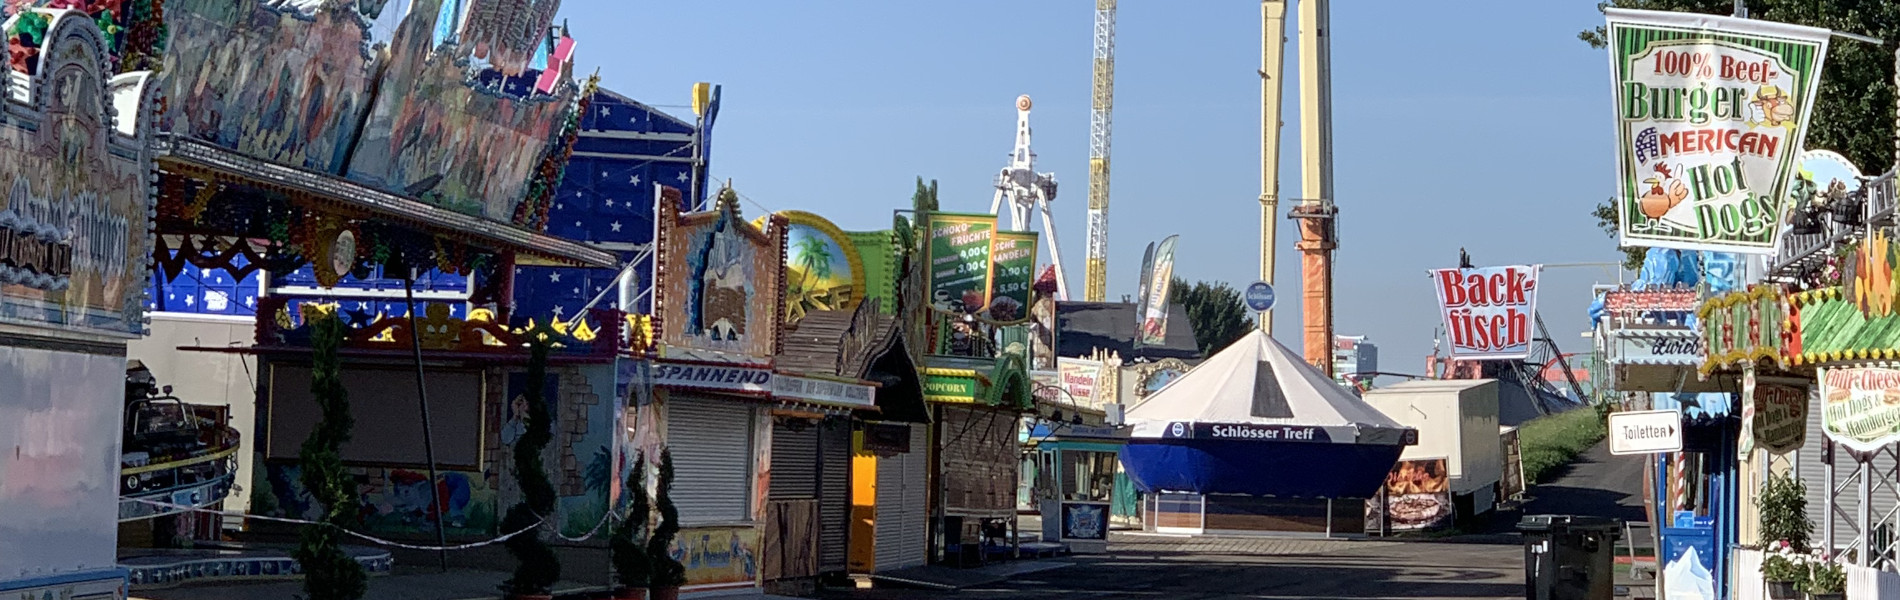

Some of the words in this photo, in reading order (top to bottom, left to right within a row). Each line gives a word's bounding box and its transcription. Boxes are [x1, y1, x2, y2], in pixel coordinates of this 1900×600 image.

[1654, 50, 1713, 79] 100%
[1719, 55, 1777, 83] Beef-
[1624, 82, 1746, 123] Burger
[1635, 126, 1779, 165] AMERICAN
[1687, 155, 1748, 202] Hot
[932, 223, 972, 239] SCHOKO-
[1694, 191, 1778, 240] Dogs
[1440, 268, 1535, 306] Back-
[1450, 308, 1527, 351] fisch
[654, 364, 770, 385] SPANNEND
[1064, 373, 1093, 387] Mandeln
[1849, 394, 1873, 416] Dogs
[1212, 425, 1279, 439] Schlösser
[1283, 427, 1314, 440] Treff
[1622, 424, 1667, 440] Toiletten
